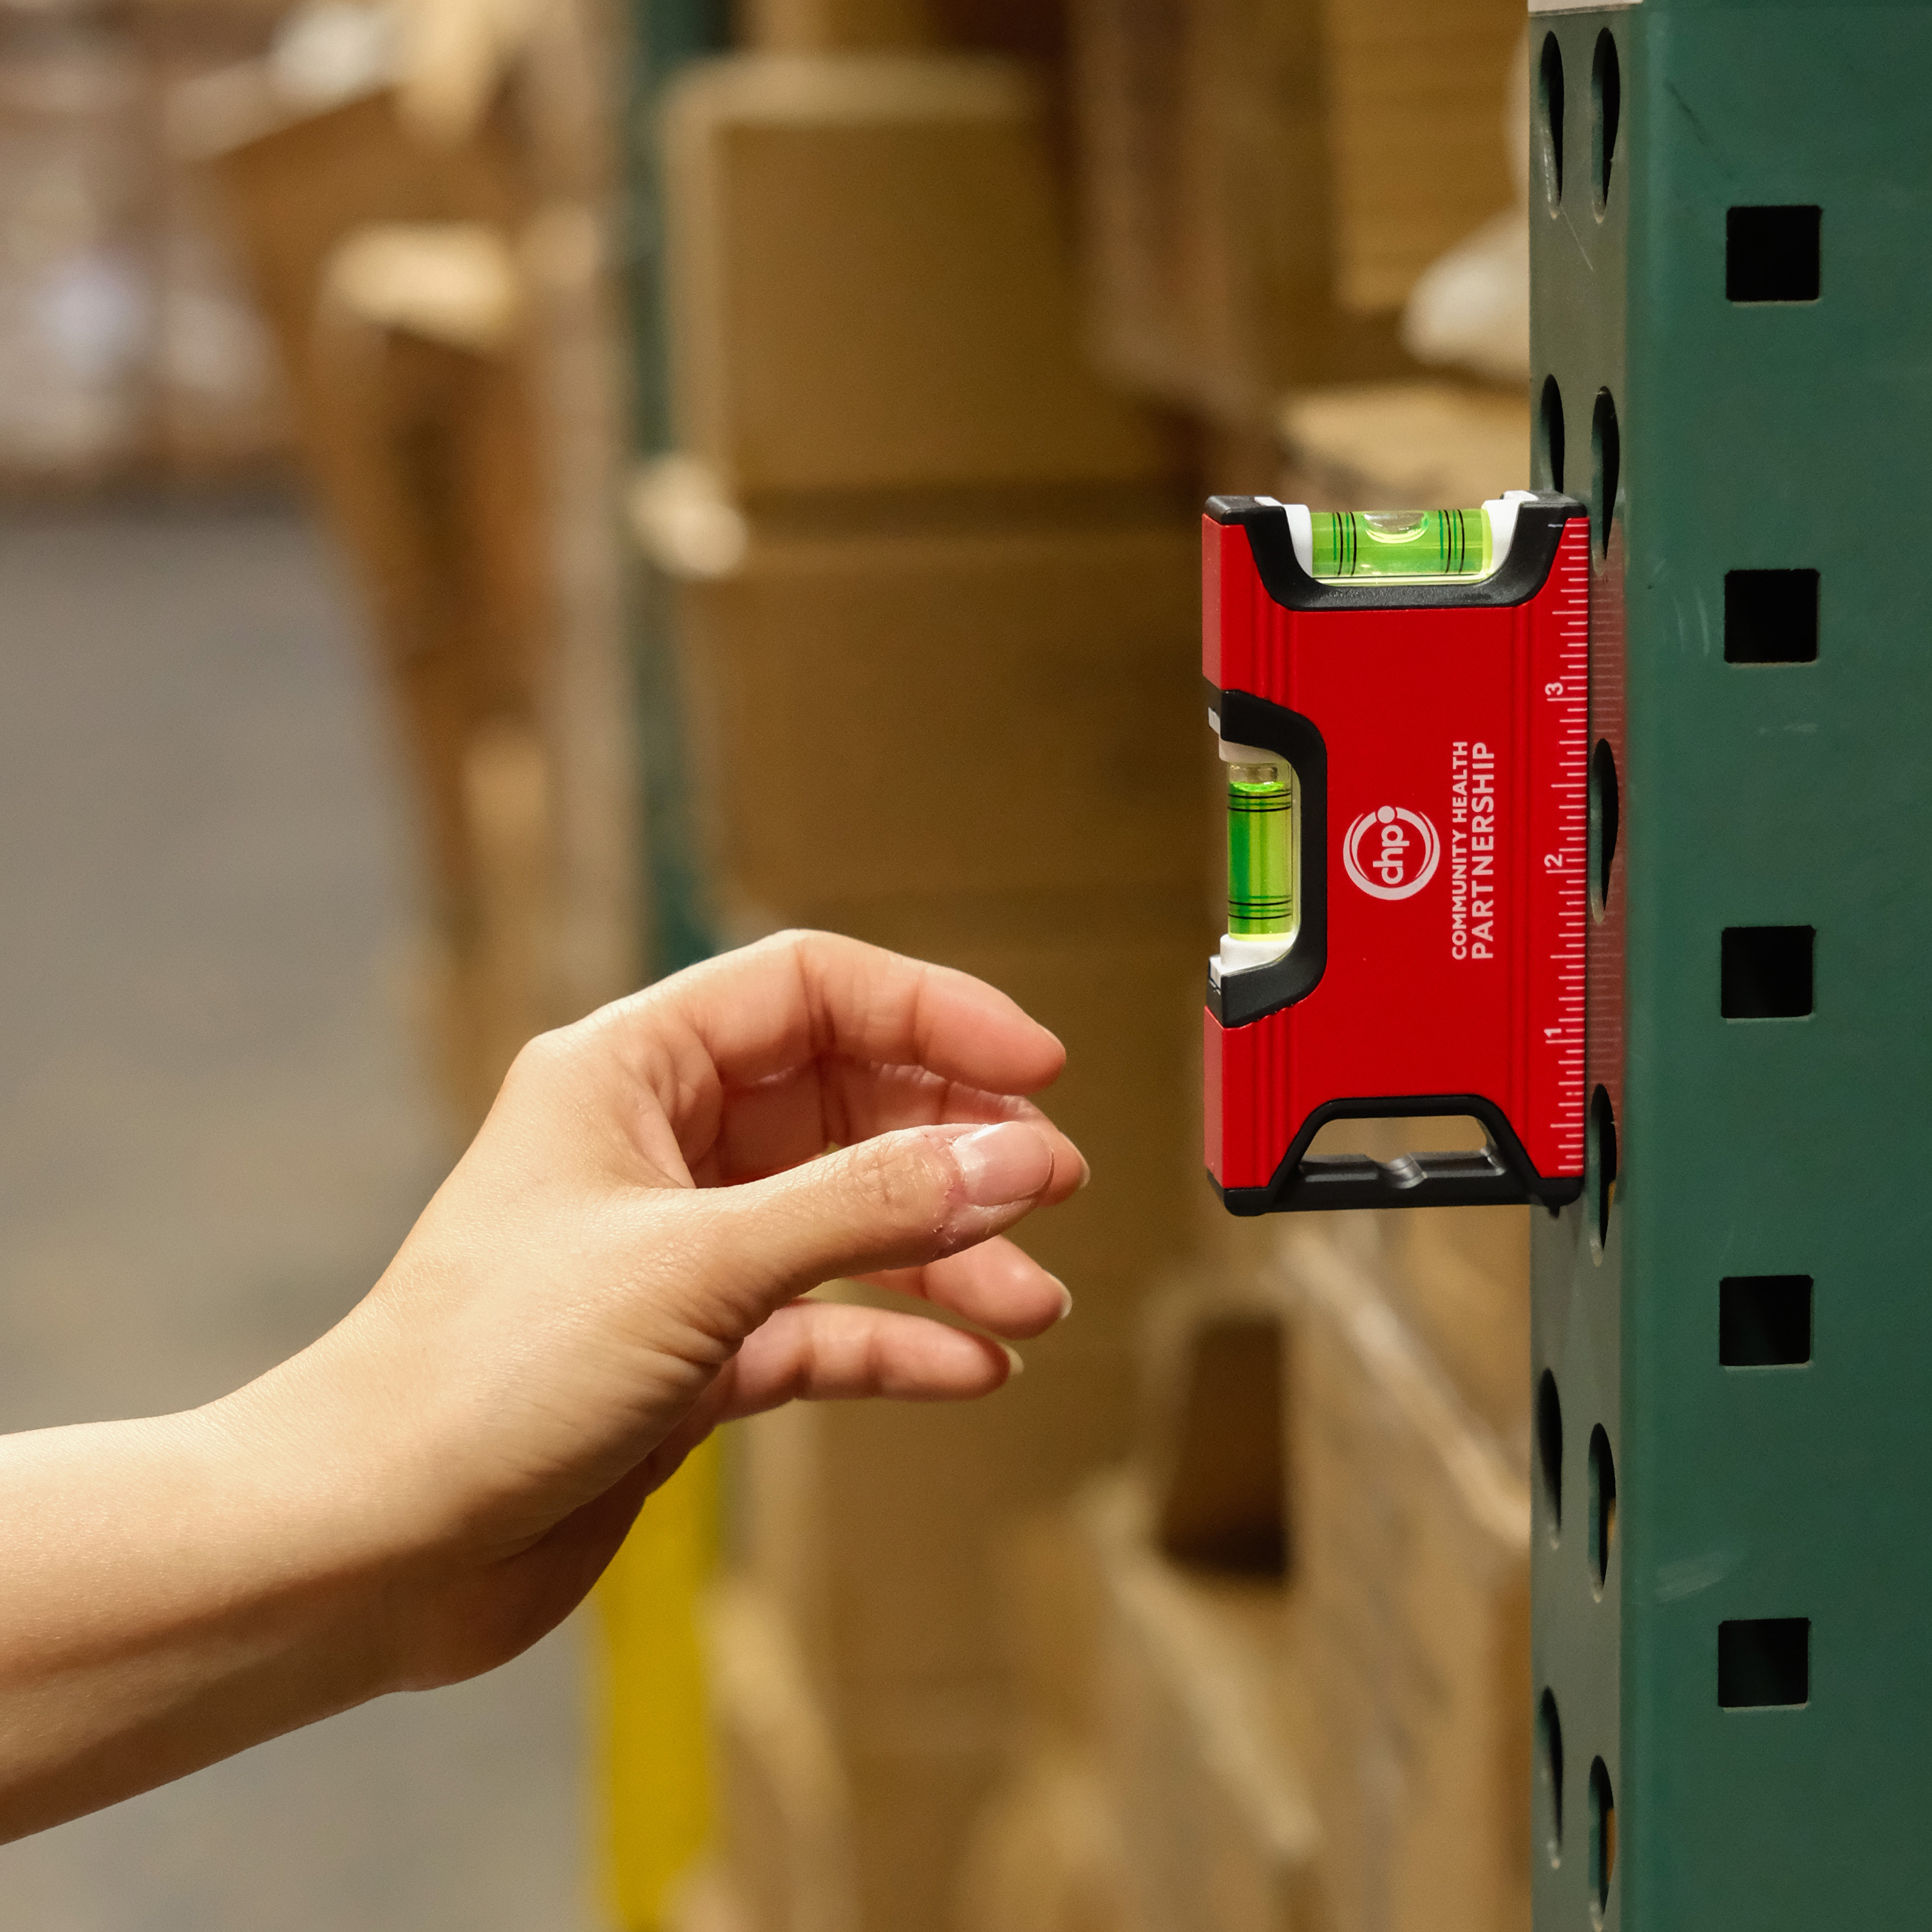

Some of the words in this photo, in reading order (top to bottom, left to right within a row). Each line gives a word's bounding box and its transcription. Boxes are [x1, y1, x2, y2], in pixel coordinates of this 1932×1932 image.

[1544, 682, 1563, 696] 3
[1452, 741, 1468, 823] HEALTH
[1372, 824, 1410, 885] chp
[1471, 742, 1495, 959] PARTNERSHIP
[1544, 853, 1562, 867] 2
[1452, 829, 1468, 960] COMMUNITY
[1544, 1028, 1562, 1037] 1
